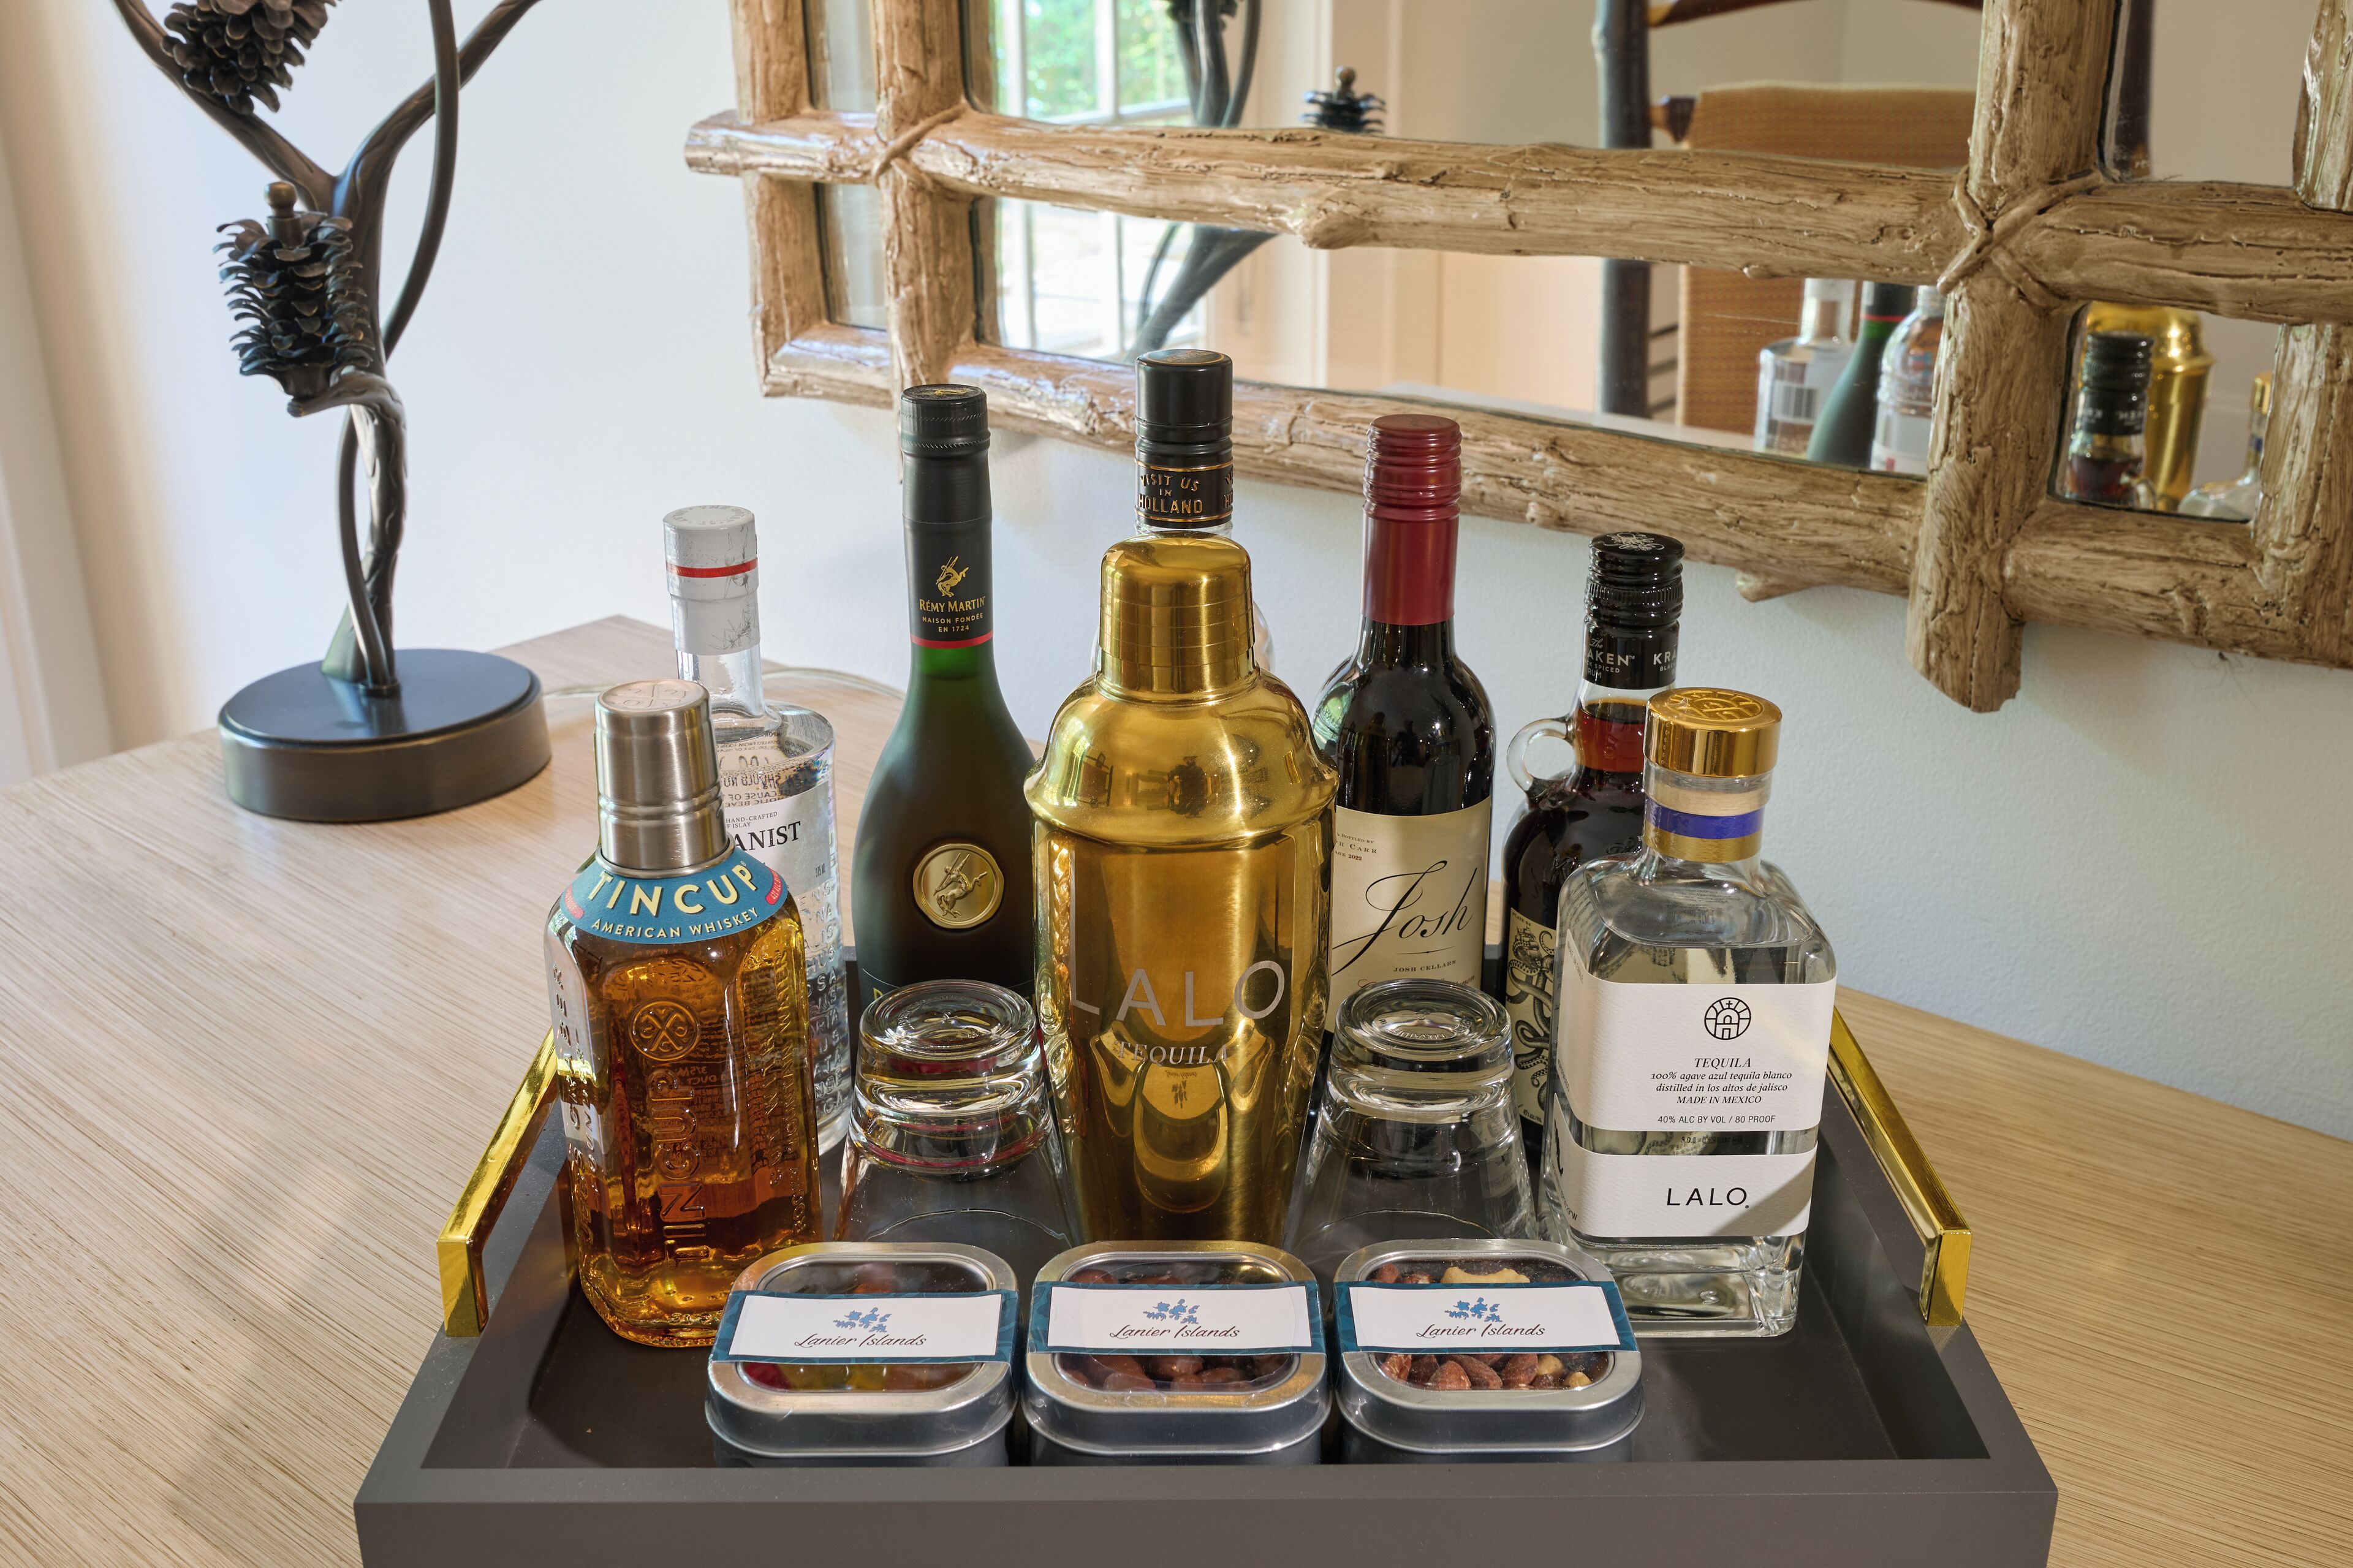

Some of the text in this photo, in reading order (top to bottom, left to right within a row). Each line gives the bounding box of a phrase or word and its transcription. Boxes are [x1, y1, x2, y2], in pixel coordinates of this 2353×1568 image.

[1140, 473, 1200, 492] VISIT US
[1139, 493, 1203, 514] HOLLAND
[919, 597, 985, 612] RÉMY MARTIN
[955, 613, 983, 623] FONDÉE
[1590, 638, 1604, 649] The
[1588, 668, 1602, 678] RUM
[1594, 664, 1620, 673] SPICED
[726, 811, 778, 824] HAND-CRAFTED
[1349, 843, 1377, 854] CARR
[588, 865, 757, 917] TINCUP
[591, 907, 760, 939] AMERICAN WHISKEY
[1332, 860, 1478, 976] Josh
[1420, 960, 1457, 971] CELLARS
[1070, 960, 1286, 1028] LALO
[1115, 1039, 1228, 1067] TEQUILA
[1694, 1058, 1752, 1069] TEQUILA
[1730, 1071, 1760, 1081] tequila
[1762, 1071, 1792, 1080] blanco
[1656, 1083, 1788, 1093] distilled in los altos de jalisco
[1667, 1187, 1747, 1206] LALO
[1109, 1325, 1240, 1339] Lanier Islands
[1416, 1324, 1545, 1338] Lanier Islands
[794, 1333, 926, 1348] Lanier Islands
